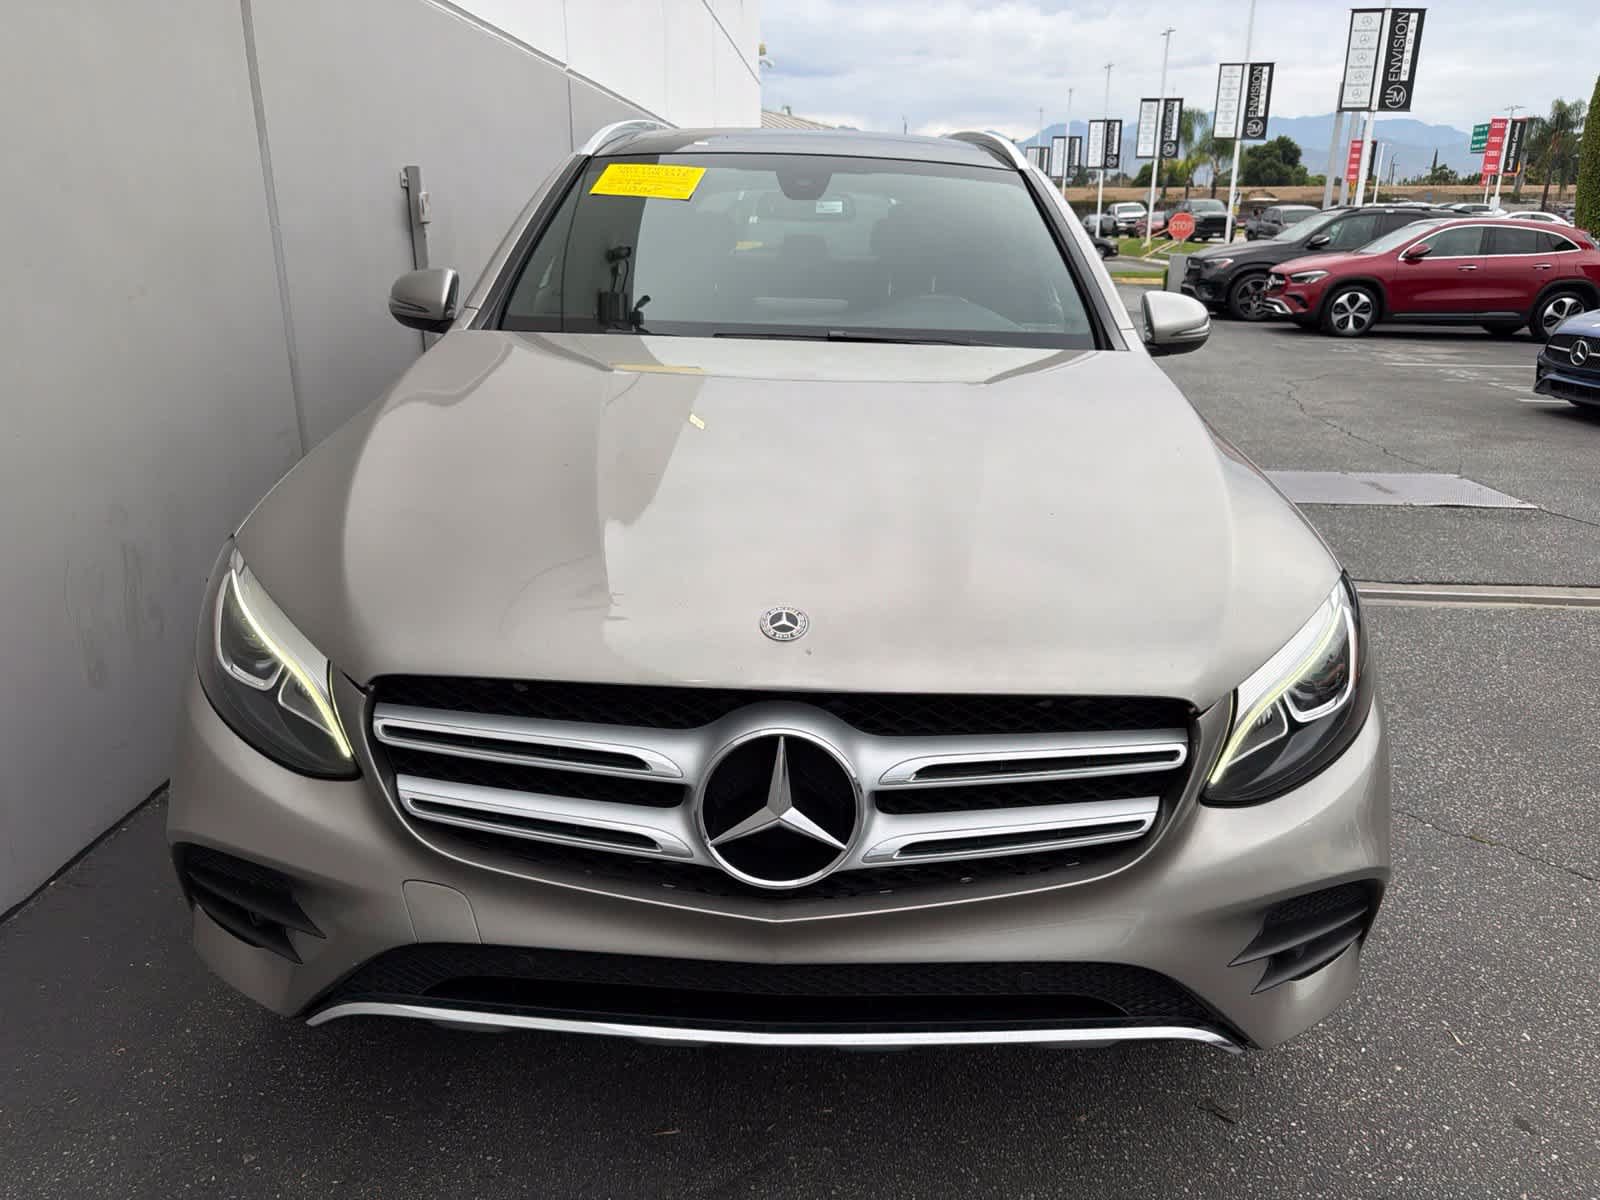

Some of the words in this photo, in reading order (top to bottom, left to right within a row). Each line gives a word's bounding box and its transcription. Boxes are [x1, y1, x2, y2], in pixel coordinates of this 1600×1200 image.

[1388, 12, 1409, 81] ENVISION
[1248, 66, 1263, 118] ENVISION
[1171, 221, 1192, 231] STOP
